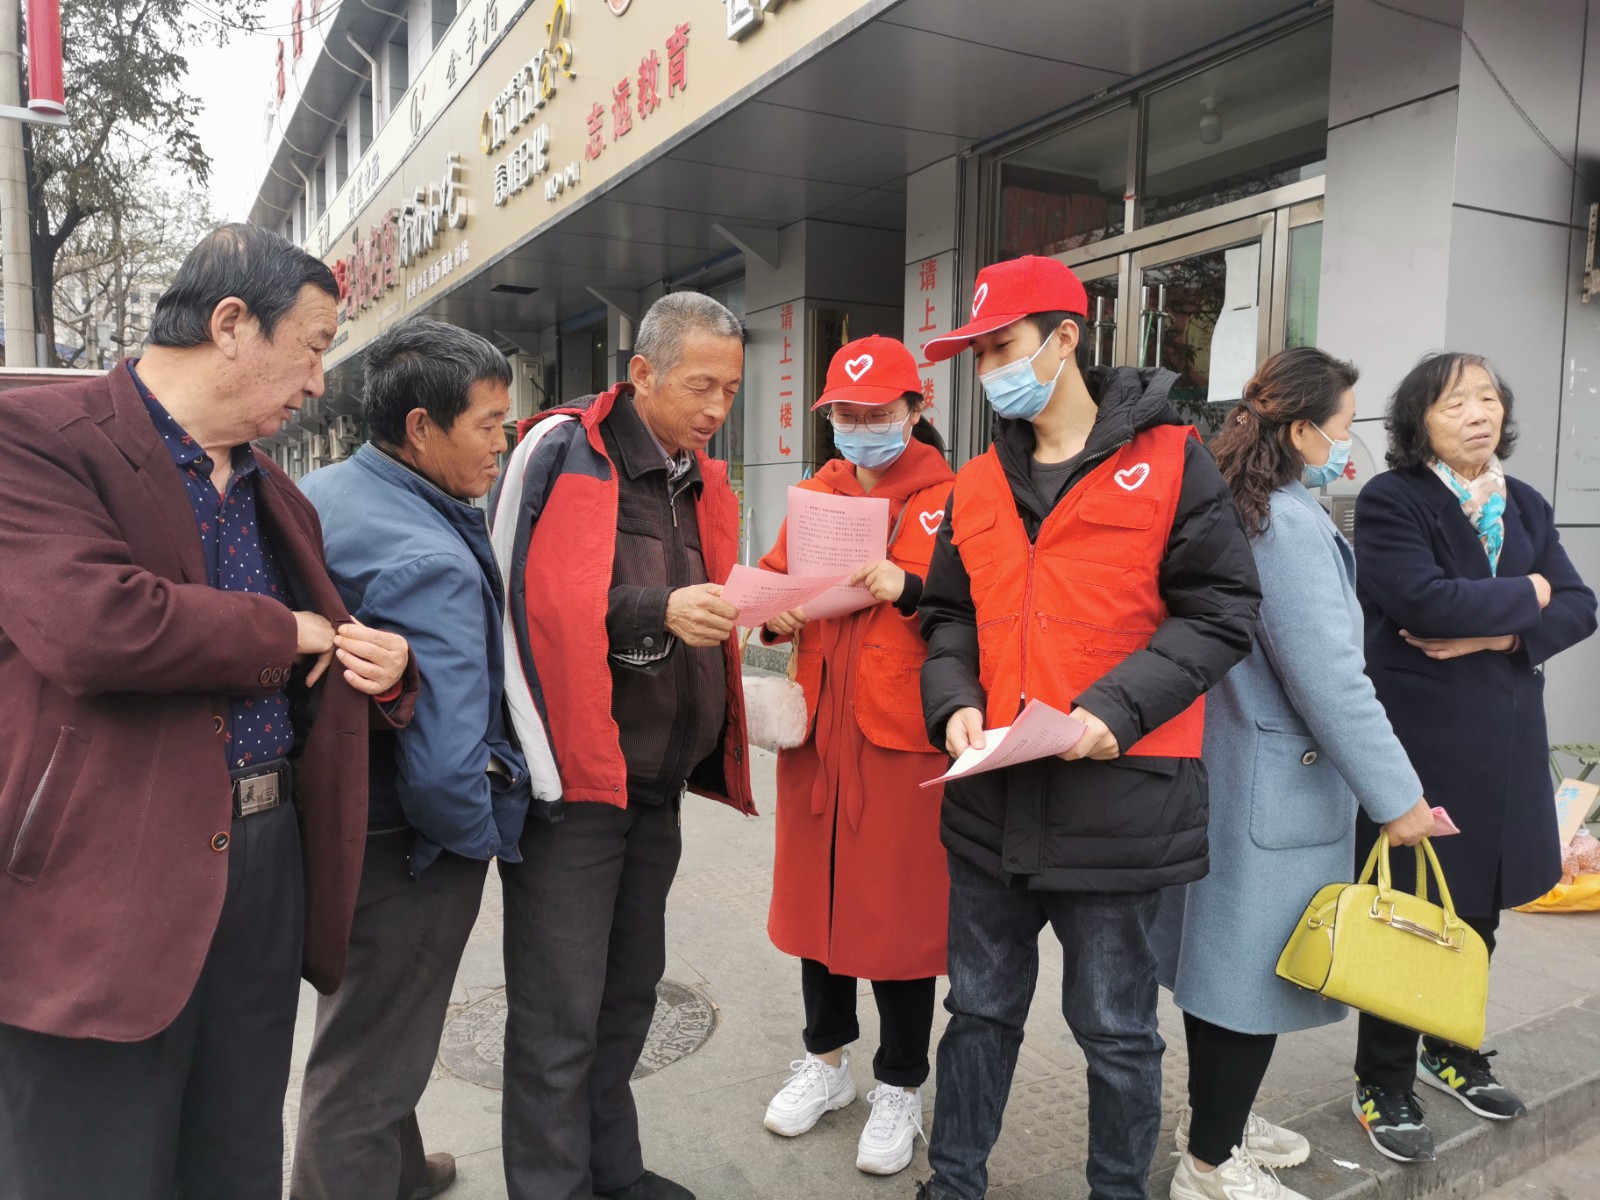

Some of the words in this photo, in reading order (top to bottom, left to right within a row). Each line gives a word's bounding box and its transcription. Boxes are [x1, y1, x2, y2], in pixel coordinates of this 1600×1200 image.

[585, 21, 690, 162] 志远教育
[779, 303, 794, 429] 请上二楼
[1362, 1099, 1381, 1122] N
[1439, 1066, 1466, 1089] N
